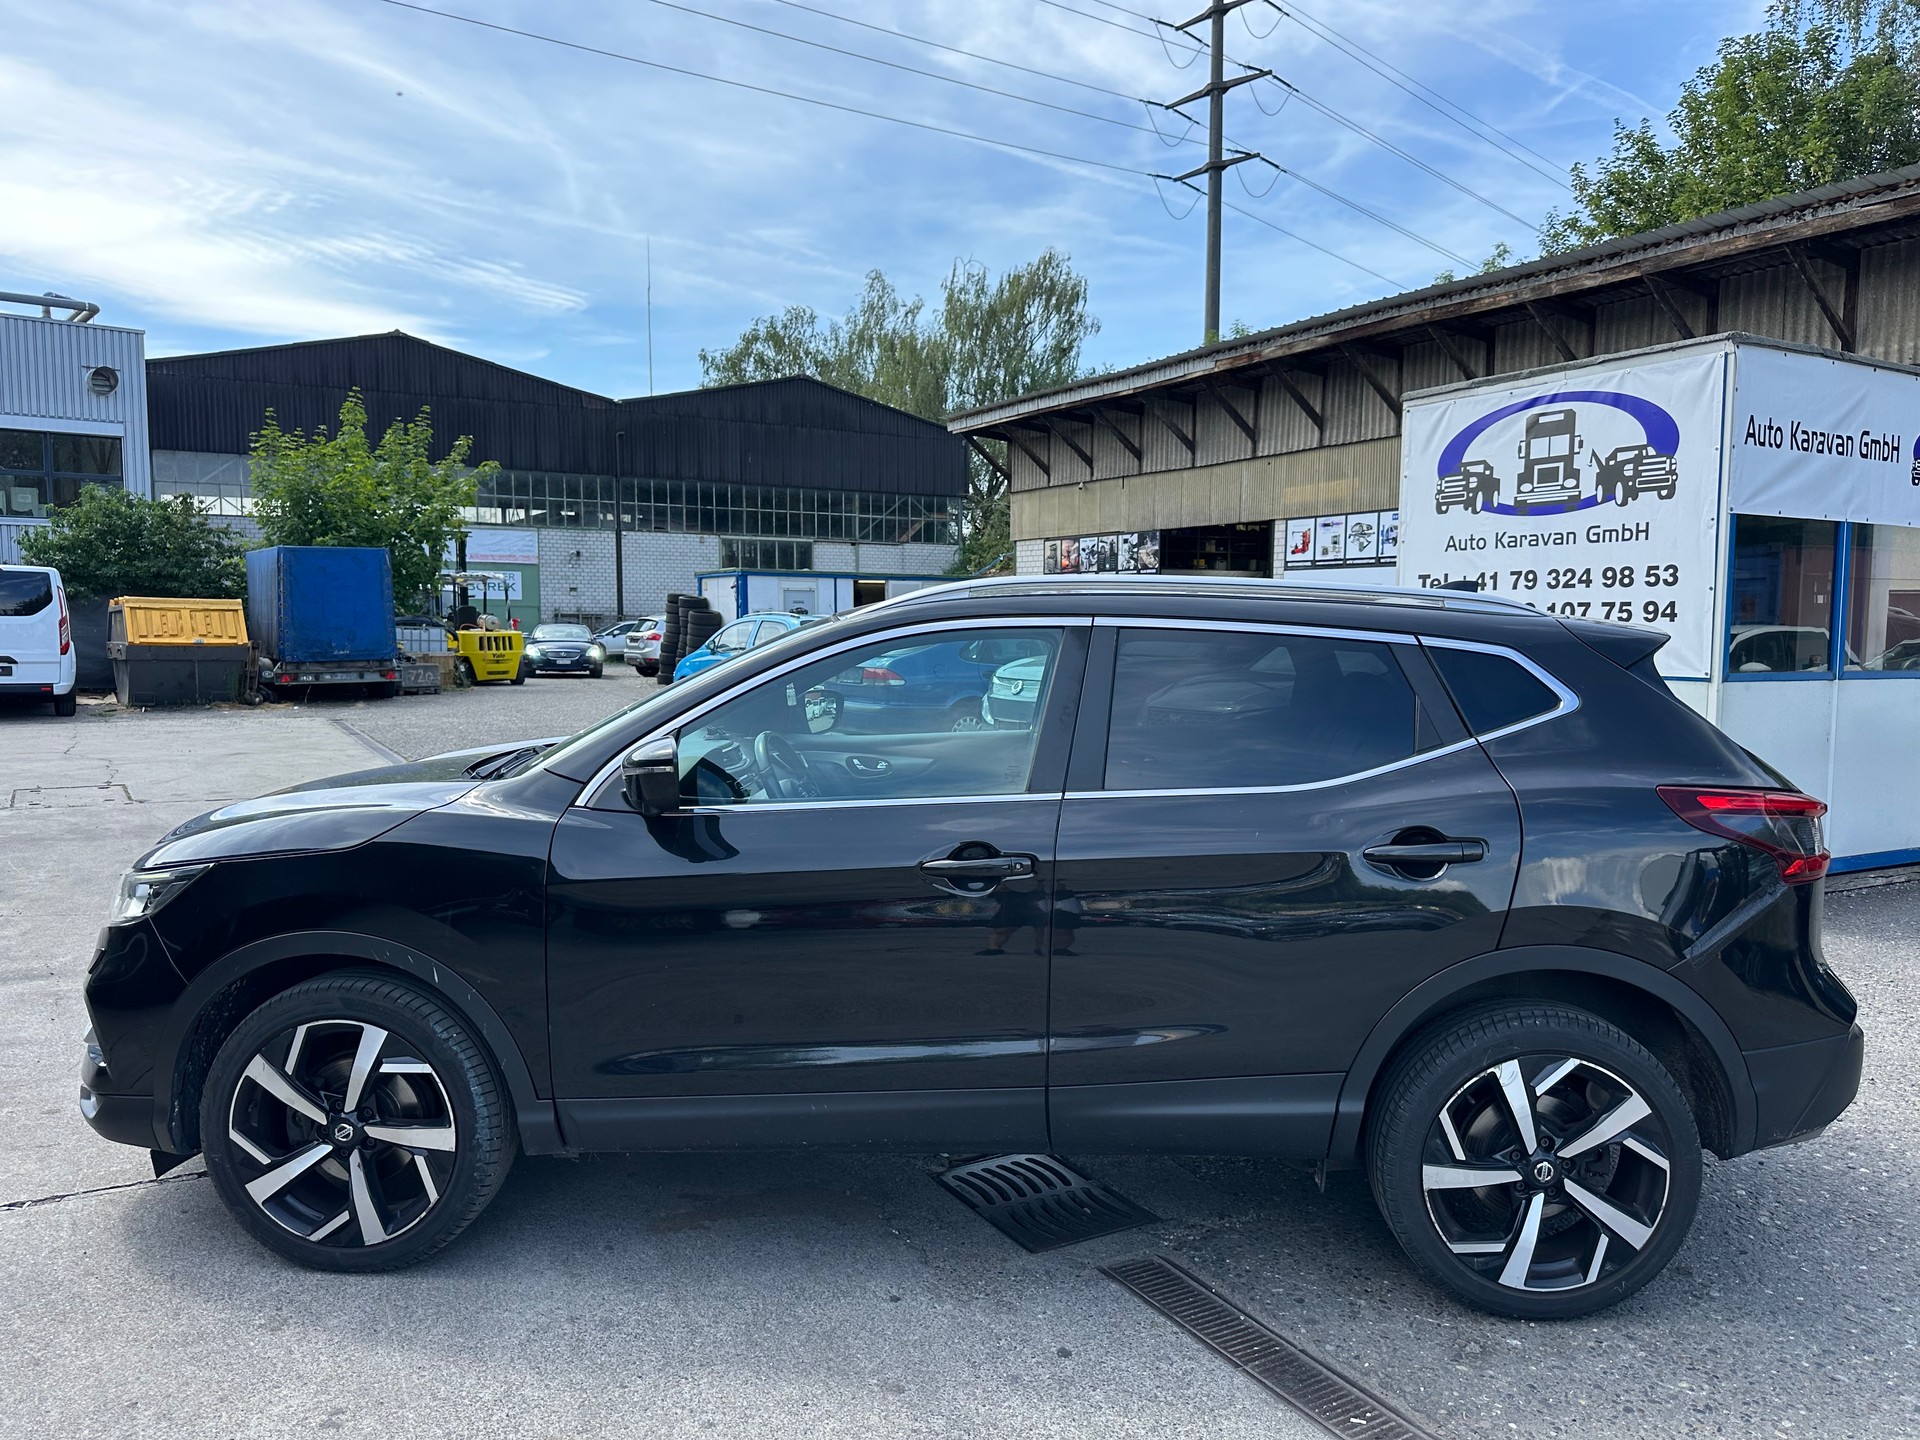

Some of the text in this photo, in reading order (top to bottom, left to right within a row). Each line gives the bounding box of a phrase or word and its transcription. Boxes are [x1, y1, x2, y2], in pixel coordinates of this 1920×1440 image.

[1744, 414, 1900, 463] Auto Karavan GmbH
[1444, 522, 1650, 552] Auto Karavan GmbH
[1509, 569, 1538, 590] 79
[1546, 567, 1592, 589] 324
[1601, 566, 1634, 588] 98
[1644, 564, 1679, 587] 53
[1601, 601, 1633, 622] 75
[1642, 600, 1678, 623] 94
